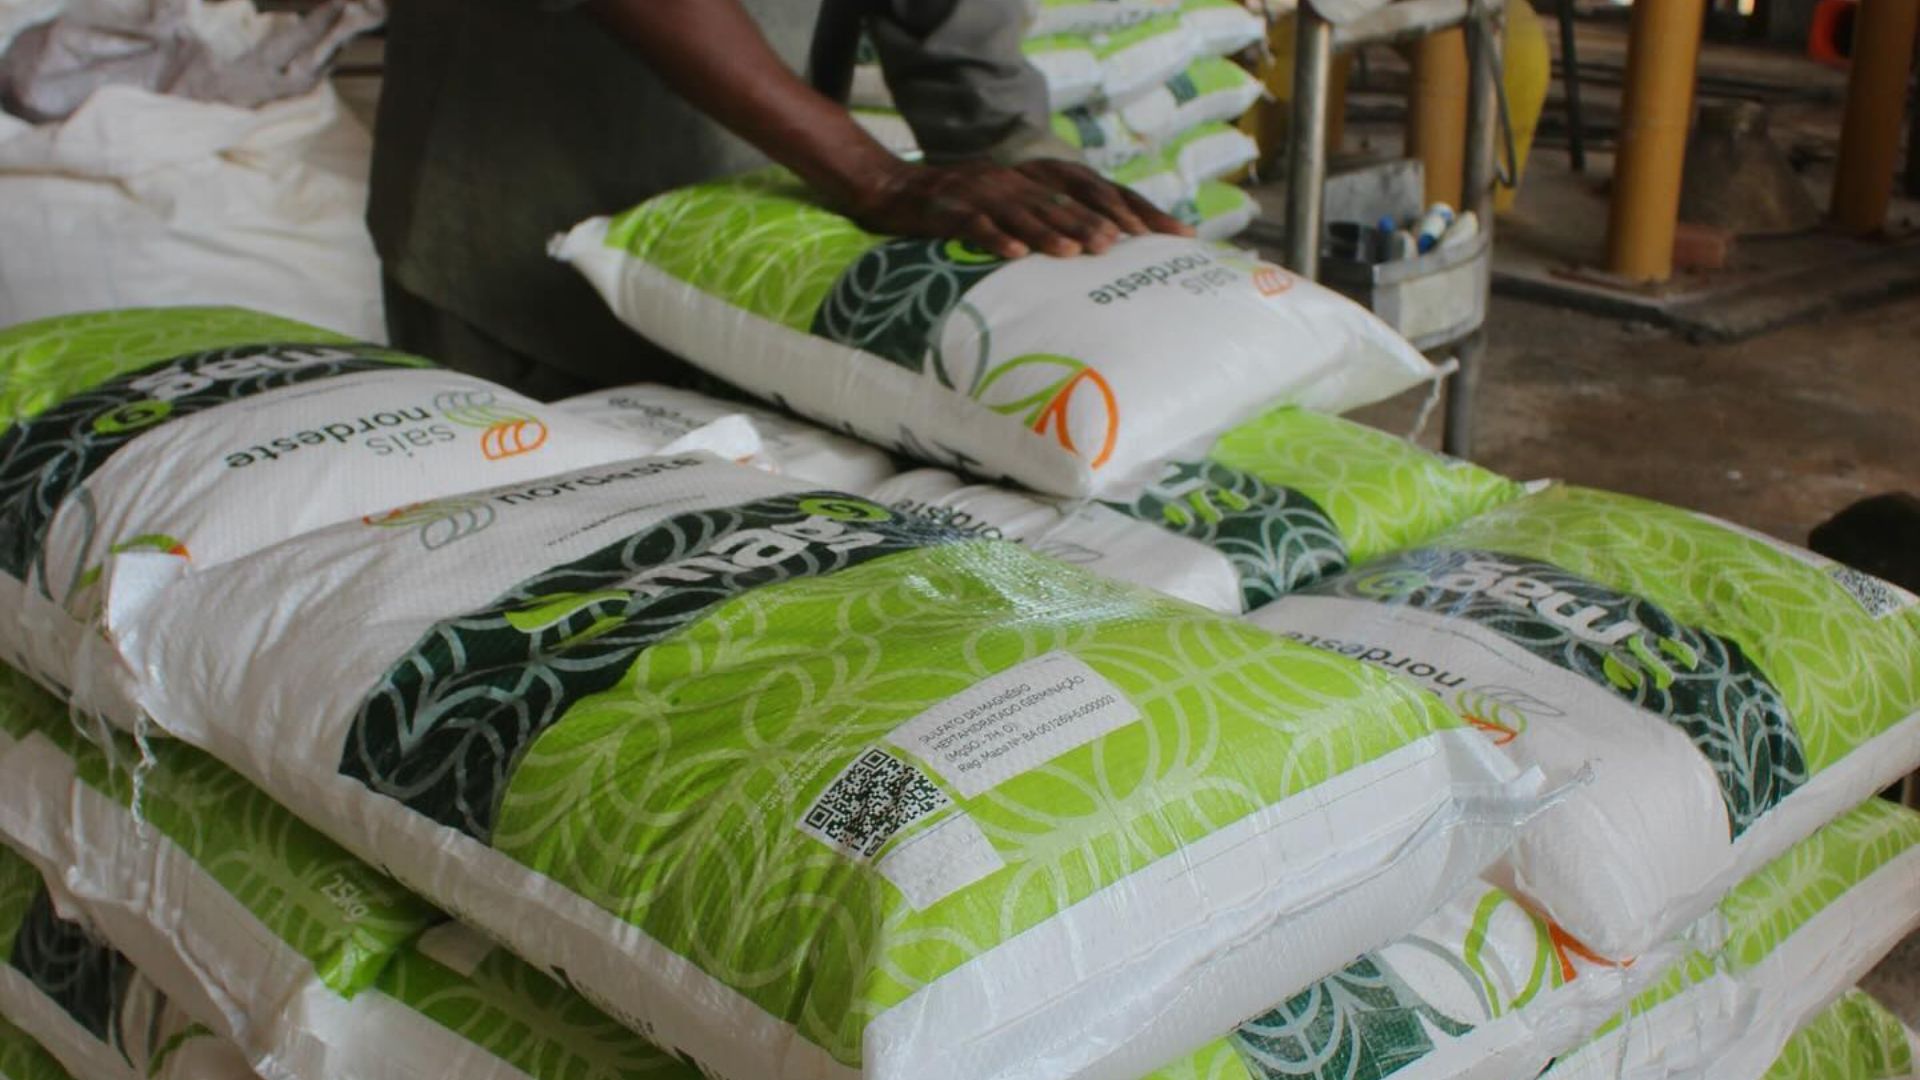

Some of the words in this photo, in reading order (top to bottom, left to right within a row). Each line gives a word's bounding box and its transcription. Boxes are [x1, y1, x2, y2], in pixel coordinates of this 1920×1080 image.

[1088, 252, 1211, 305] nordeste
[226, 406, 433, 468] nordeste
[365, 423, 456, 458] sais
[932, 702, 1023, 751] HEPTAHIDRATADO
[320, 873, 369, 922] 25kg
